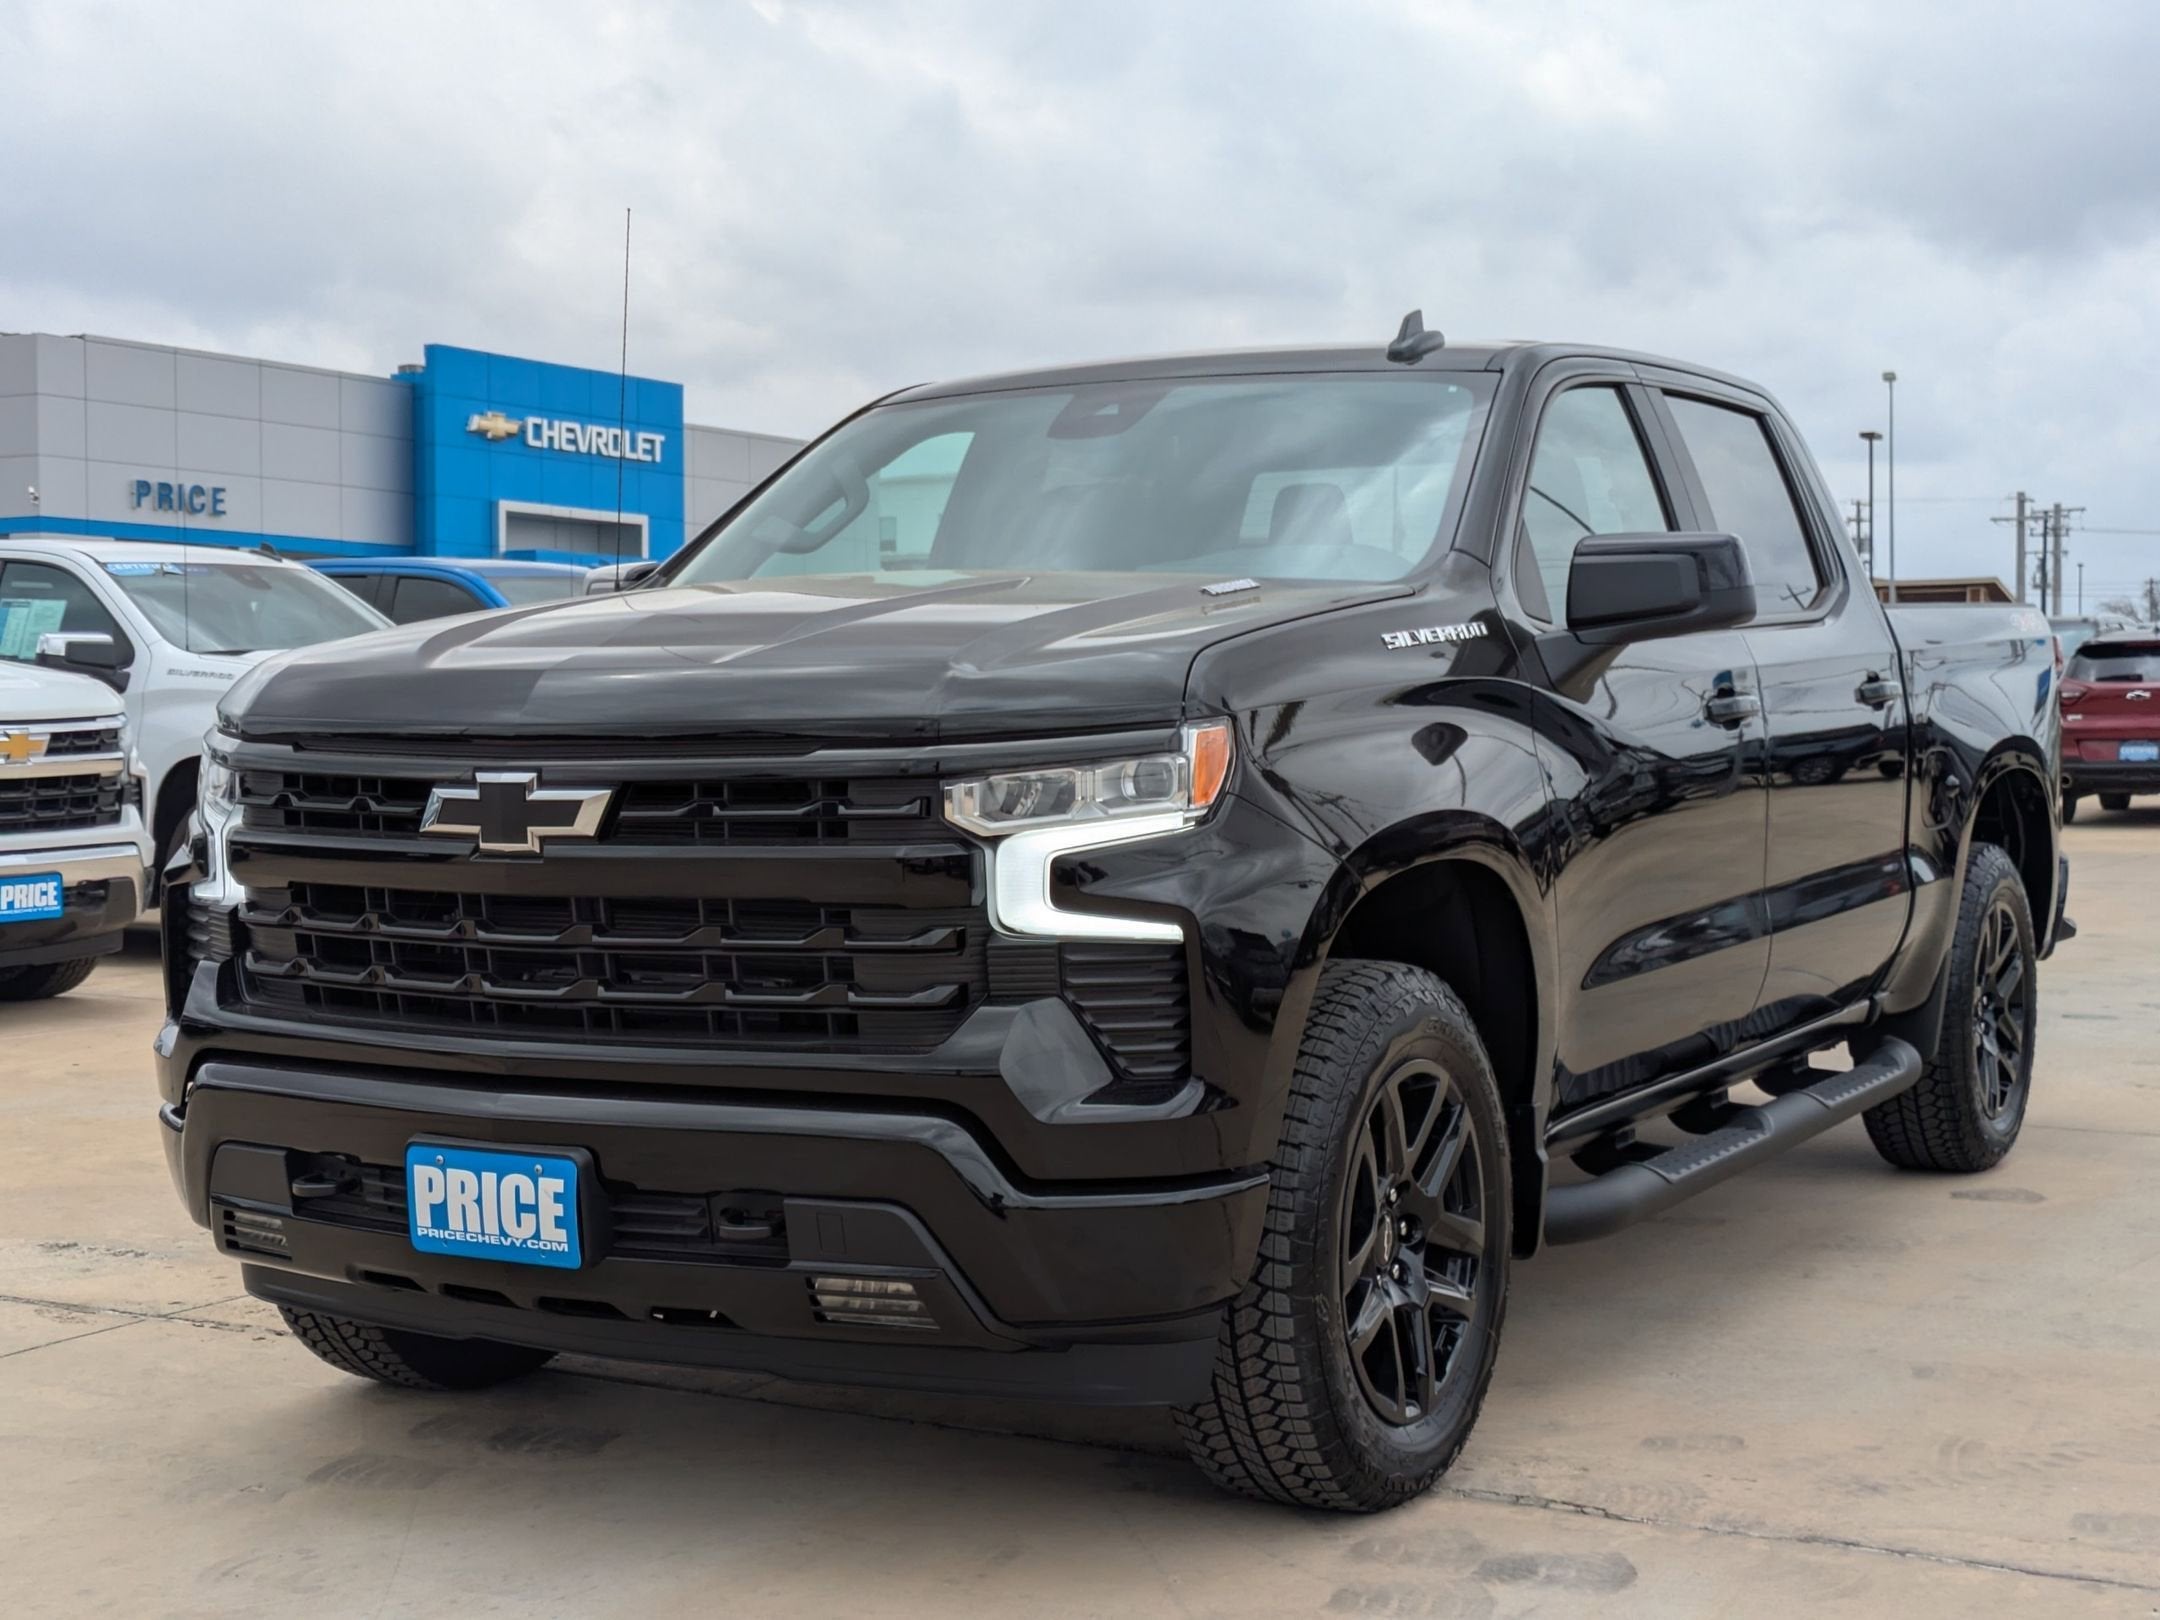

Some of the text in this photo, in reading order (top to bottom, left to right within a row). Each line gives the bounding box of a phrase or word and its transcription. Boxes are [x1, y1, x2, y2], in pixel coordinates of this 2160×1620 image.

[525, 416, 666, 463] CHEVROLET
[133, 479, 227, 515] PRICE
[1381, 621, 1489, 650] SILVERADO
[0, 881, 58, 910] PRICE
[413, 1164, 567, 1242] PRICE
[417, 1227, 569, 1252] PRICECHEVY.COM
